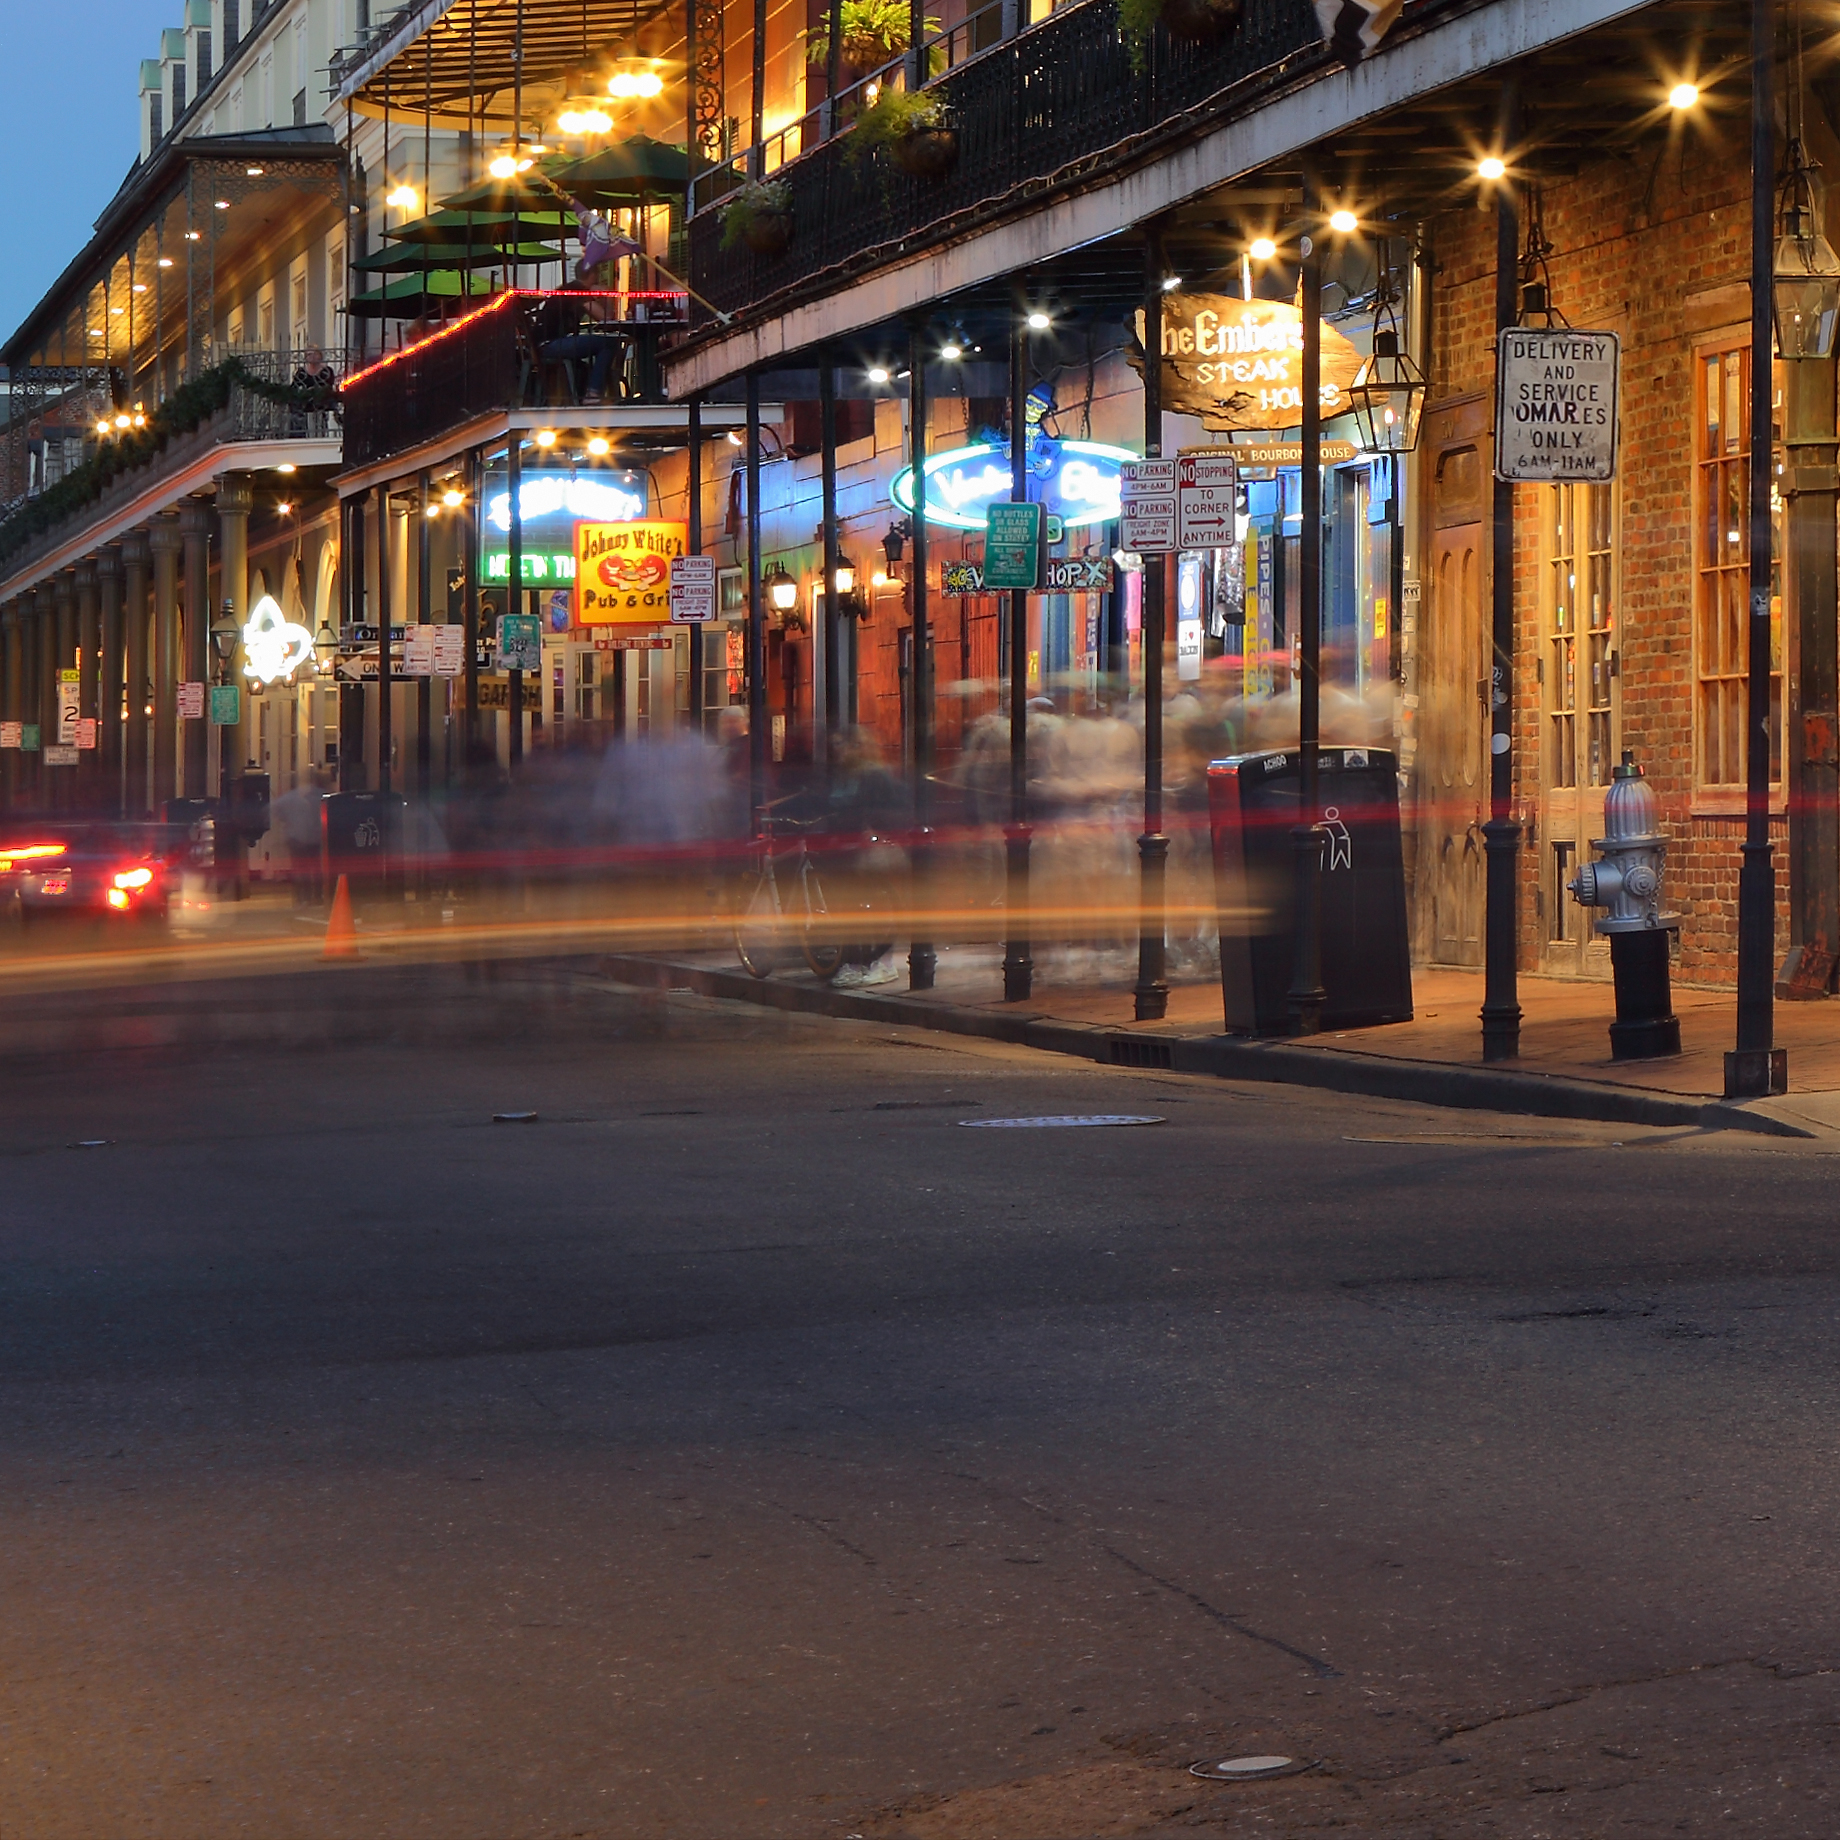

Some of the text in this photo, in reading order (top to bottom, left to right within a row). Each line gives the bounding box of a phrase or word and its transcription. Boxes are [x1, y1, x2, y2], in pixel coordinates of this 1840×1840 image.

[1514, 341, 1606, 361] DELIVERY
[1197, 357, 1290, 385] STEAK
[1544, 365, 1575, 380] AND
[1519, 383, 1599, 402] SERVICE
[1516, 402, 1577, 423] OMAR
[1533, 431, 1583, 449] ONLY
[1251, 444, 1303, 461] BOURBON
[1321, 446, 1351, 459] OUSE
[1518, 454, 1596, 470] 6AM-11AM
[1121, 463, 1172, 478] NO PARKING
[1180, 464, 1233, 482] NO STOPPING
[1131, 482, 1167, 491] 4PM-6AM
[1201, 489, 1214, 500] TO
[1003, 510, 1034, 518] BOTTLES
[1140, 503, 1173, 515] PARKING
[1185, 502, 1230, 515] CORNER
[996, 526, 1028, 534] ALLOWED
[1126, 520, 1170, 528] FREIGHT ZONE
[1131, 528, 1168, 537] 6AM-4PM
[1184, 530, 1232, 543] ANYTIME
[582, 529, 683, 562] Johnny White's
[672, 560, 711, 570] NO PARKING
[1259, 535, 1271, 615] PIPES
[584, 589, 671, 610] Pub & Gri
[672, 587, 711, 597] NO PARKING
